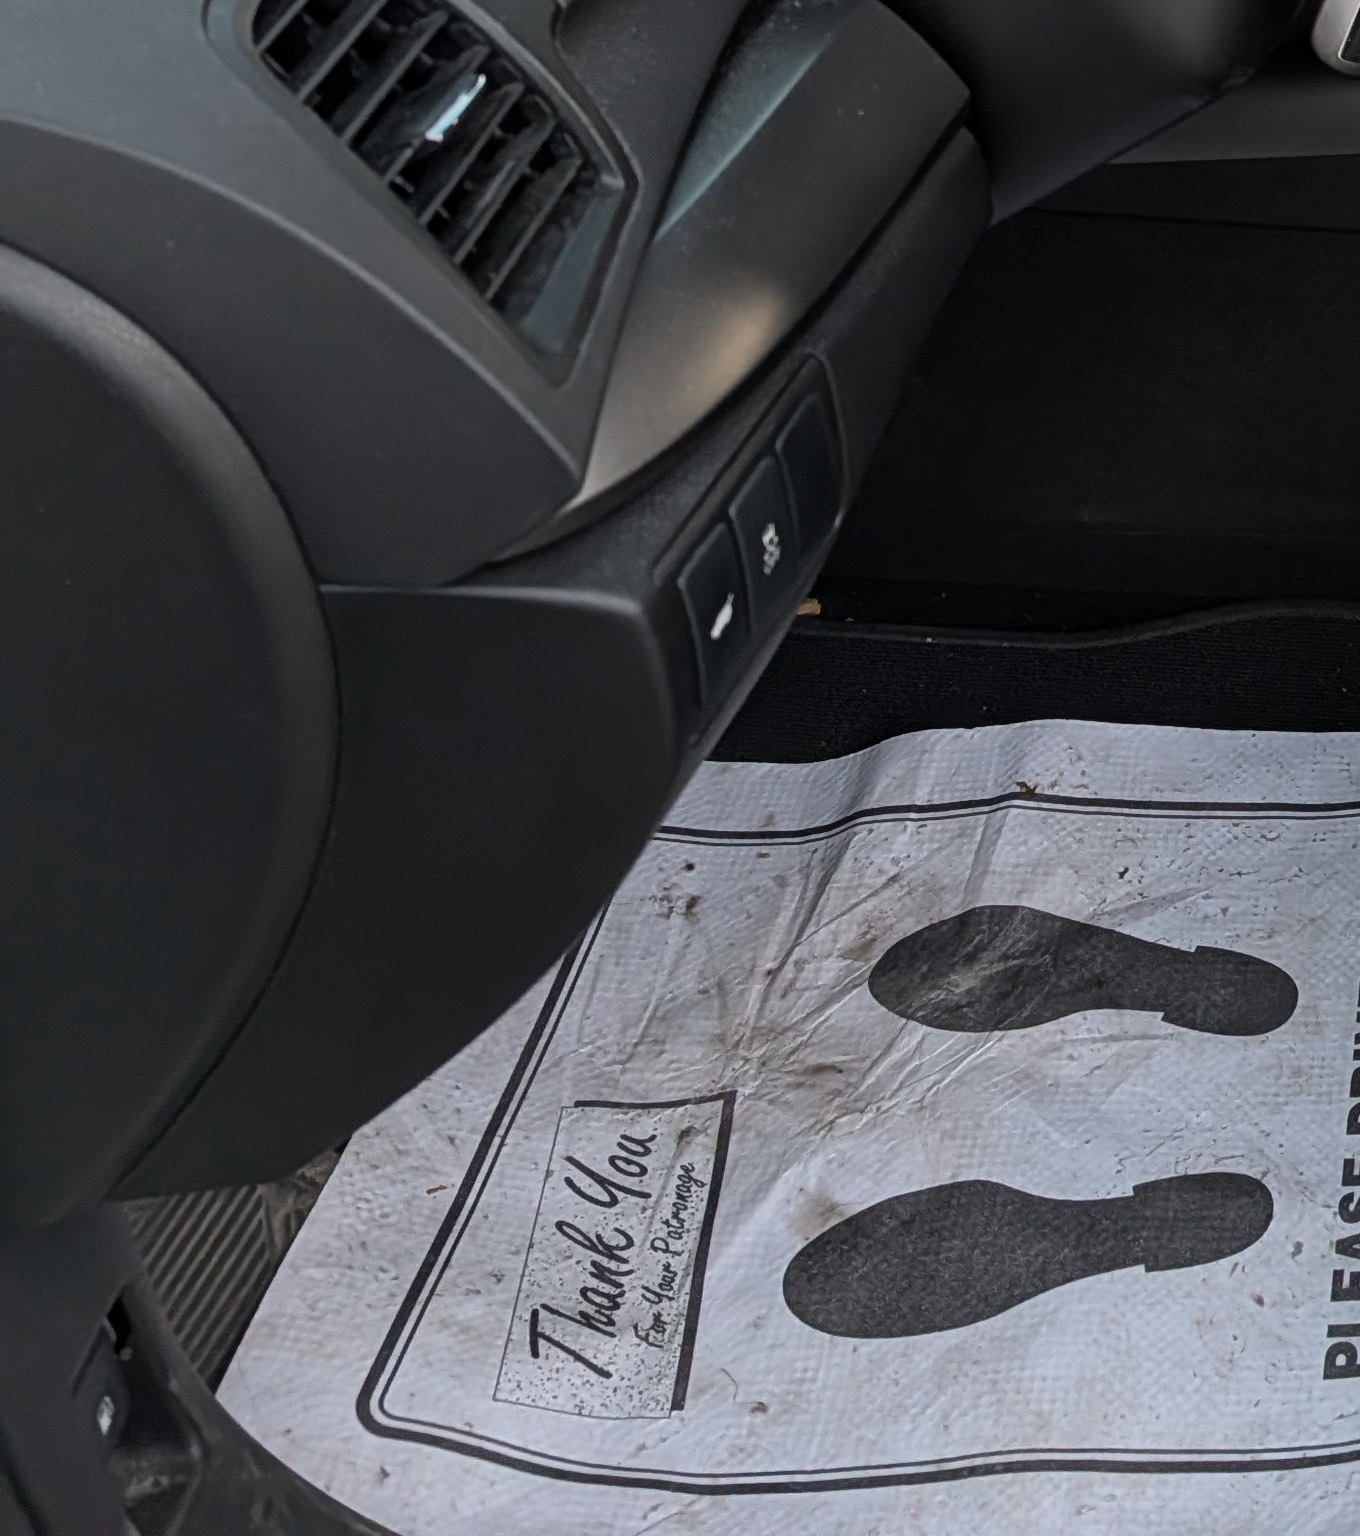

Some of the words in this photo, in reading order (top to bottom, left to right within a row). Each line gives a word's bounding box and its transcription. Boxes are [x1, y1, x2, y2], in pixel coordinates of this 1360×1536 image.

[565, 1133, 657, 1208] You
[651, 1163, 708, 1257] Patronage
[529, 1220, 635, 1379] Thank
[641, 1262, 699, 1305] Your
[632, 1310, 669, 1348] For
